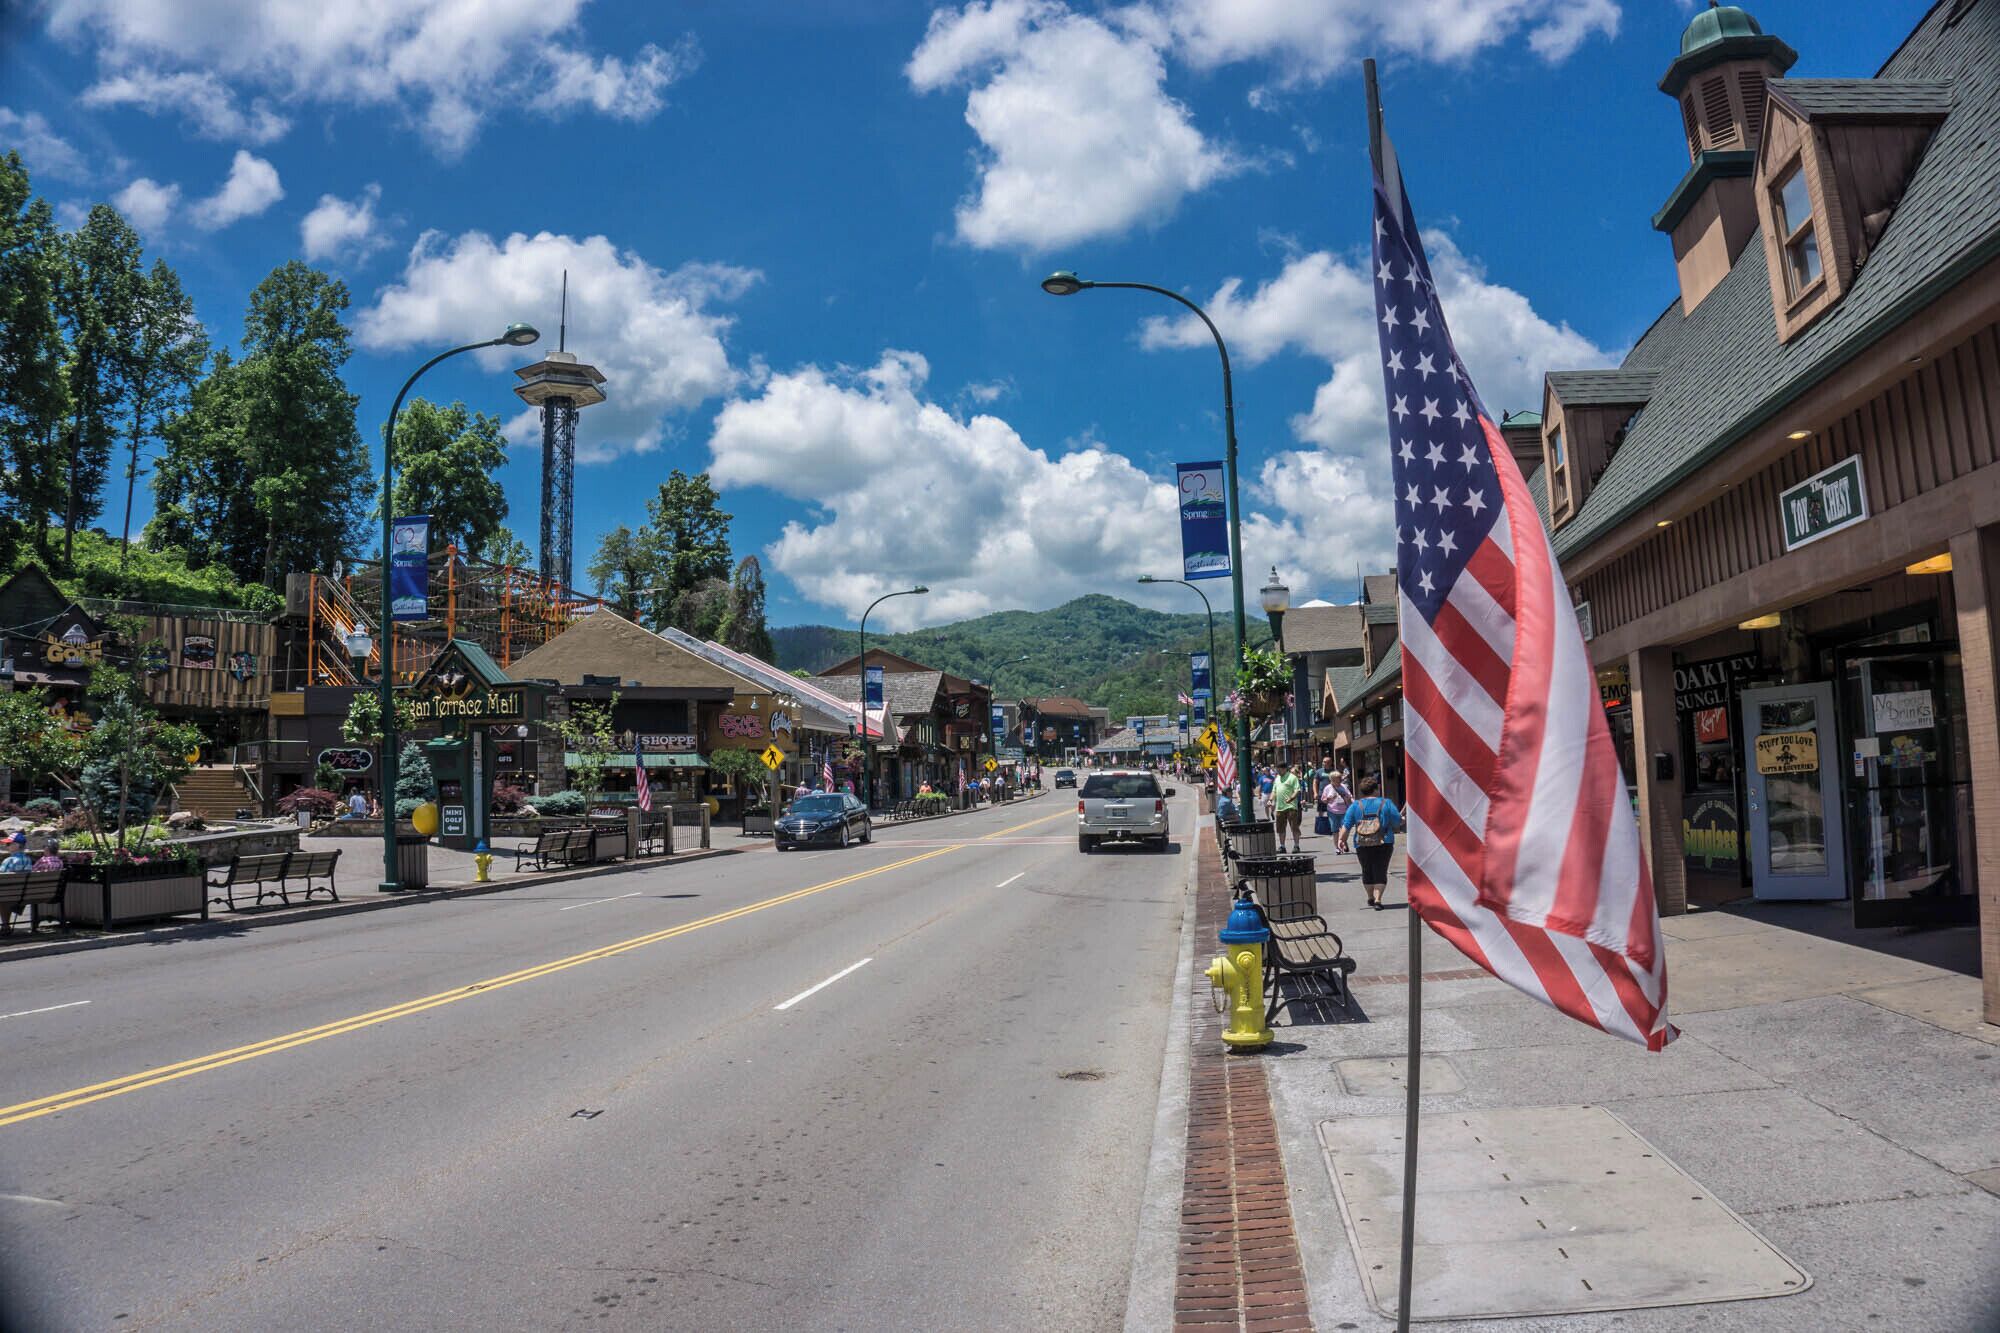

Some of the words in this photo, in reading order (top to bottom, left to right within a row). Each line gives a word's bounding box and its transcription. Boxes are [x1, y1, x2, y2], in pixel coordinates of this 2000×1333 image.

[1810, 480, 1824, 493] The
[1791, 497, 1810, 537] TOY
[1823, 476, 1852, 524] CHEST
[432, 694, 482, 718] Terrace
[486, 692, 518, 715] Mall
[1875, 695, 1892, 712] No
[1889, 704, 1931, 721] Drinks
[641, 736, 696, 745] SHOPPE
[1758, 738, 1780, 751] STUFF
[1780, 735, 1795, 746] YOU
[1795, 735, 1814, 747] LOVE
